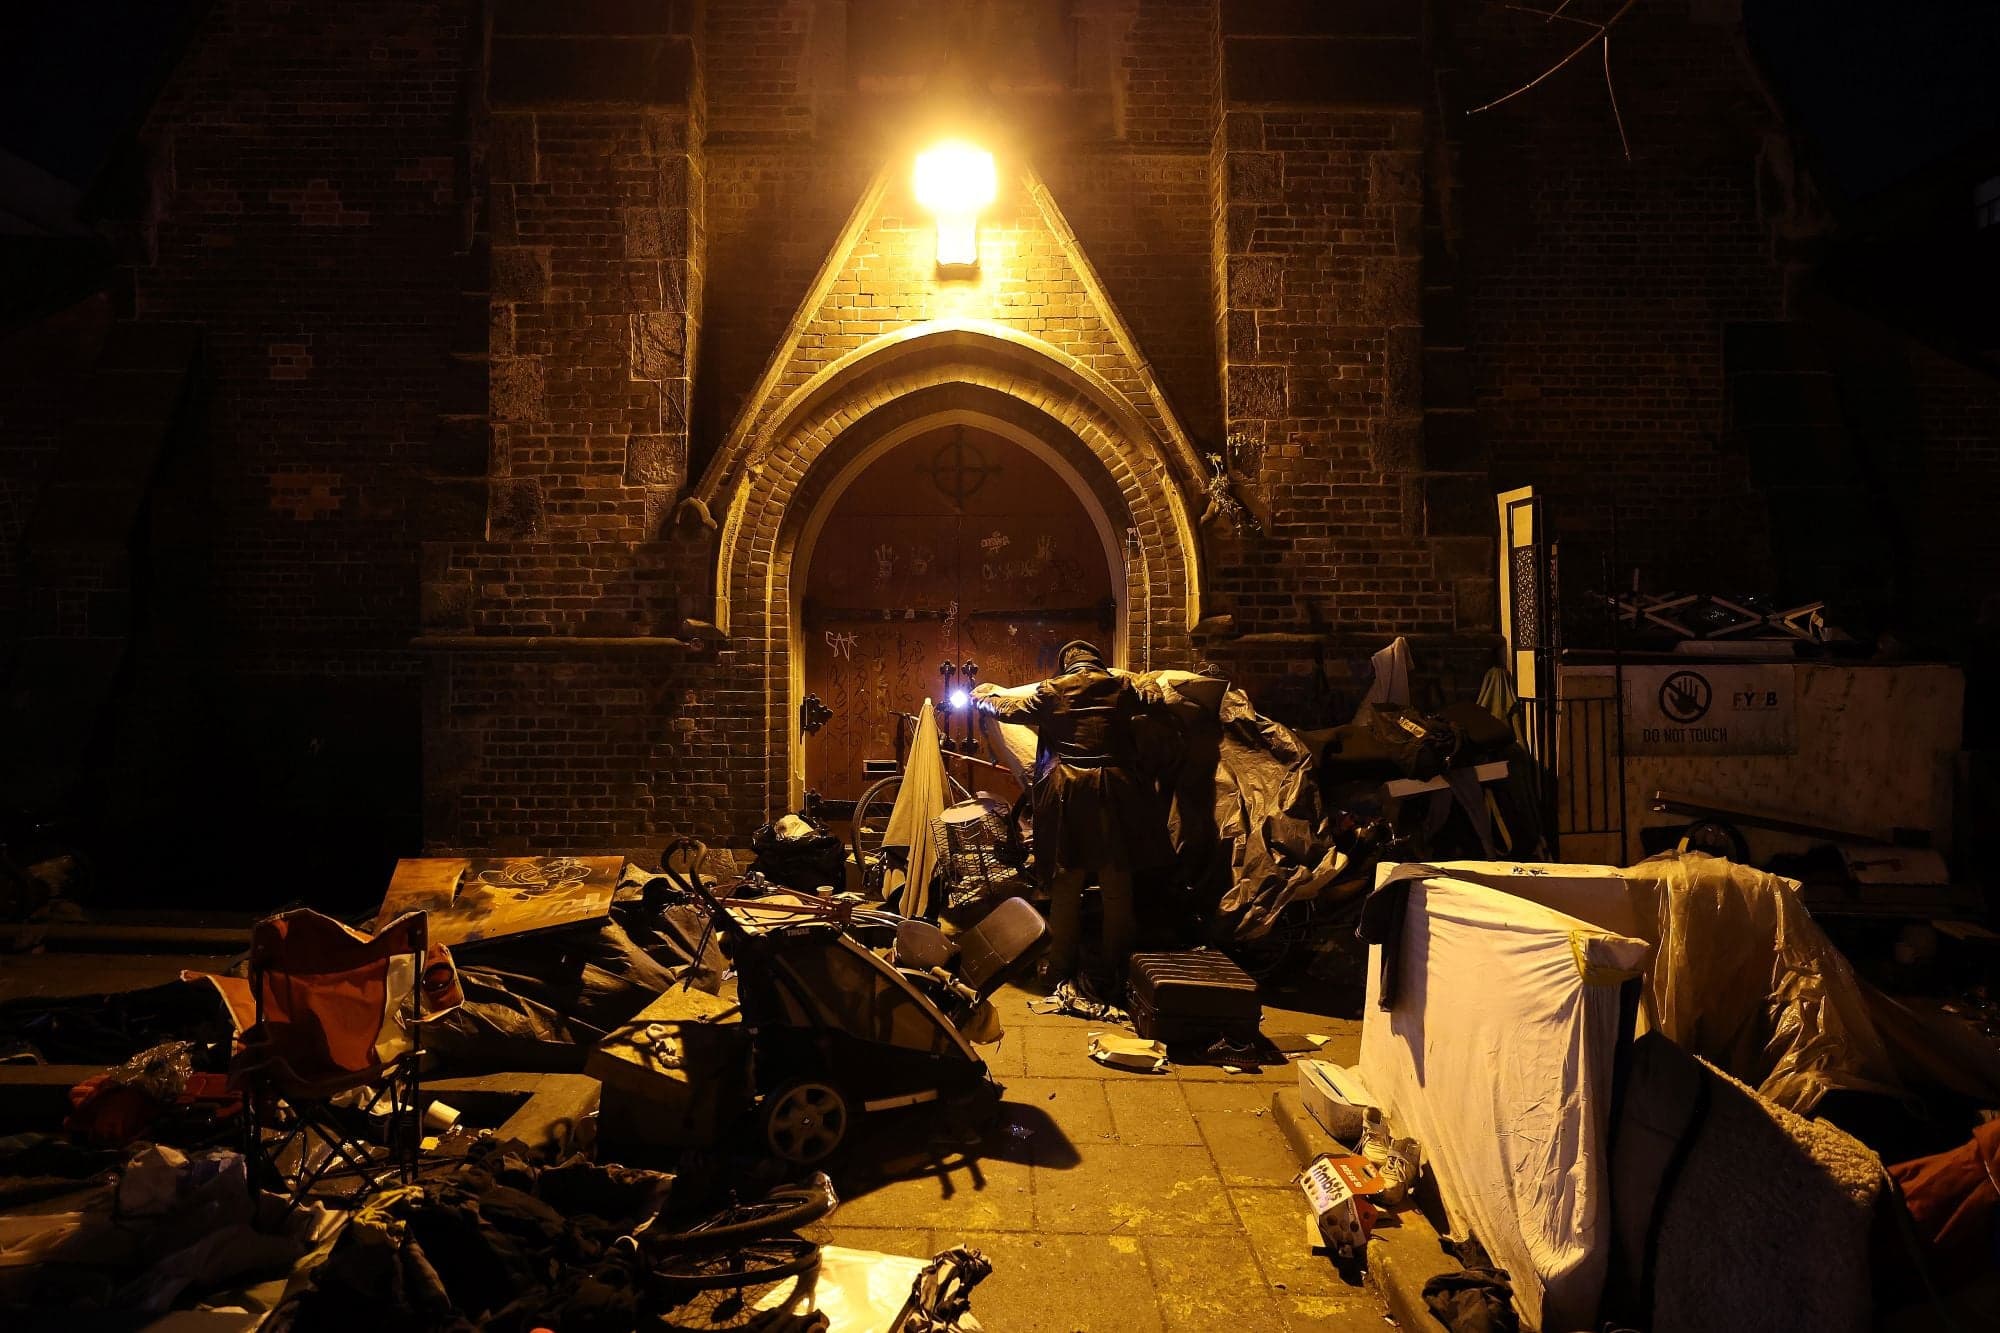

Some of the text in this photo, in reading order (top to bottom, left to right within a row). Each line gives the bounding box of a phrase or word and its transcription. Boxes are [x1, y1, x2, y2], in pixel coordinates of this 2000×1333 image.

[1643, 727, 1728, 743] DO NOT TOUCH
